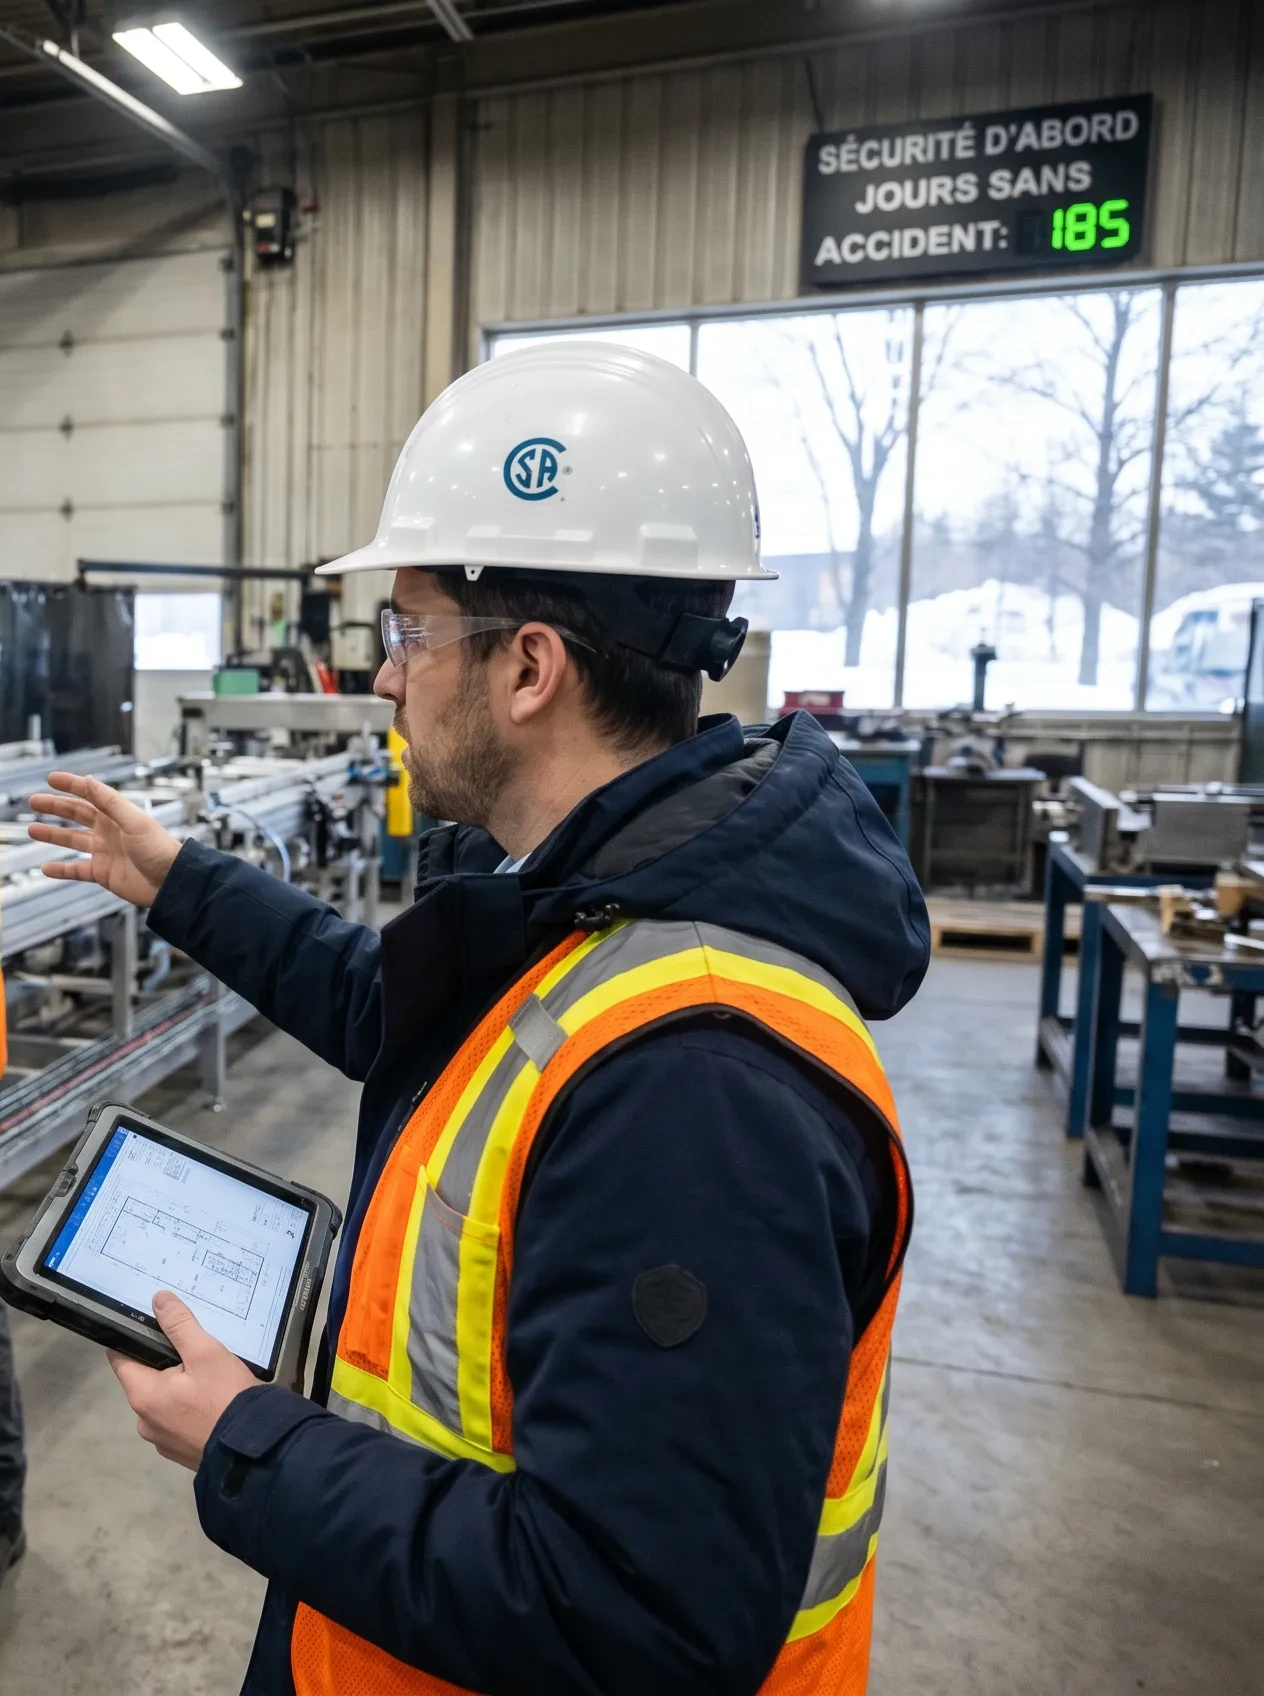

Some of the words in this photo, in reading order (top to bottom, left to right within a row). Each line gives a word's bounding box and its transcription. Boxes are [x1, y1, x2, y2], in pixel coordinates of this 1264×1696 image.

[818, 121, 976, 174] SÉCURITÉ
[984, 110, 1138, 156] D'ABORD
[855, 172, 979, 214] JOURS
[988, 161, 1092, 200] SANS
[813, 220, 1009, 266] ACCIDENT:
[1052, 199, 1130, 251] 185
